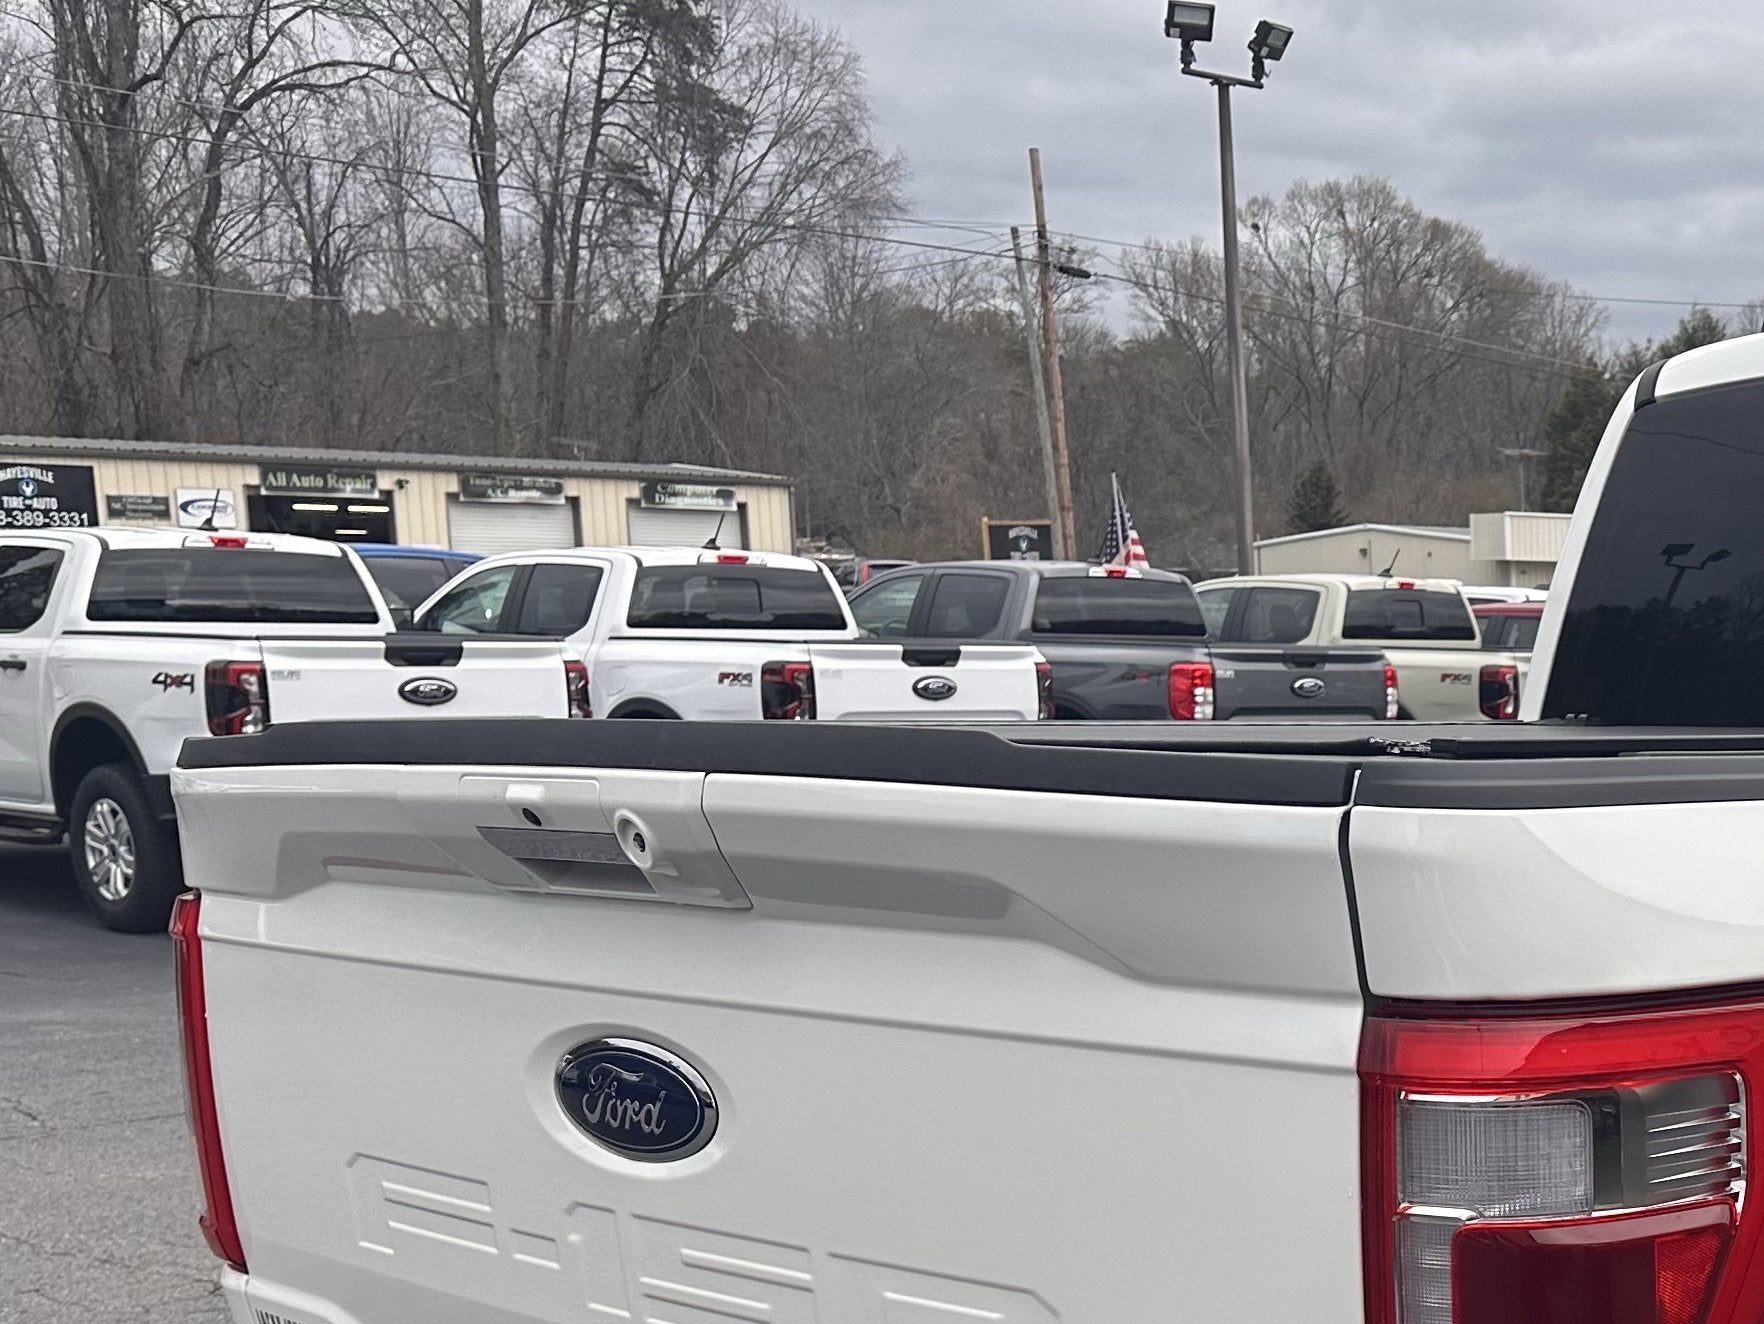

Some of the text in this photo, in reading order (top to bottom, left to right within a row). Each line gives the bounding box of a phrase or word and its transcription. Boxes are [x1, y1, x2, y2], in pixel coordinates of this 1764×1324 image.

[265, 471, 374, 493] All Auto Repair
[718, 671, 753, 685] FX4
[581, 1062, 667, 1135] Ford
